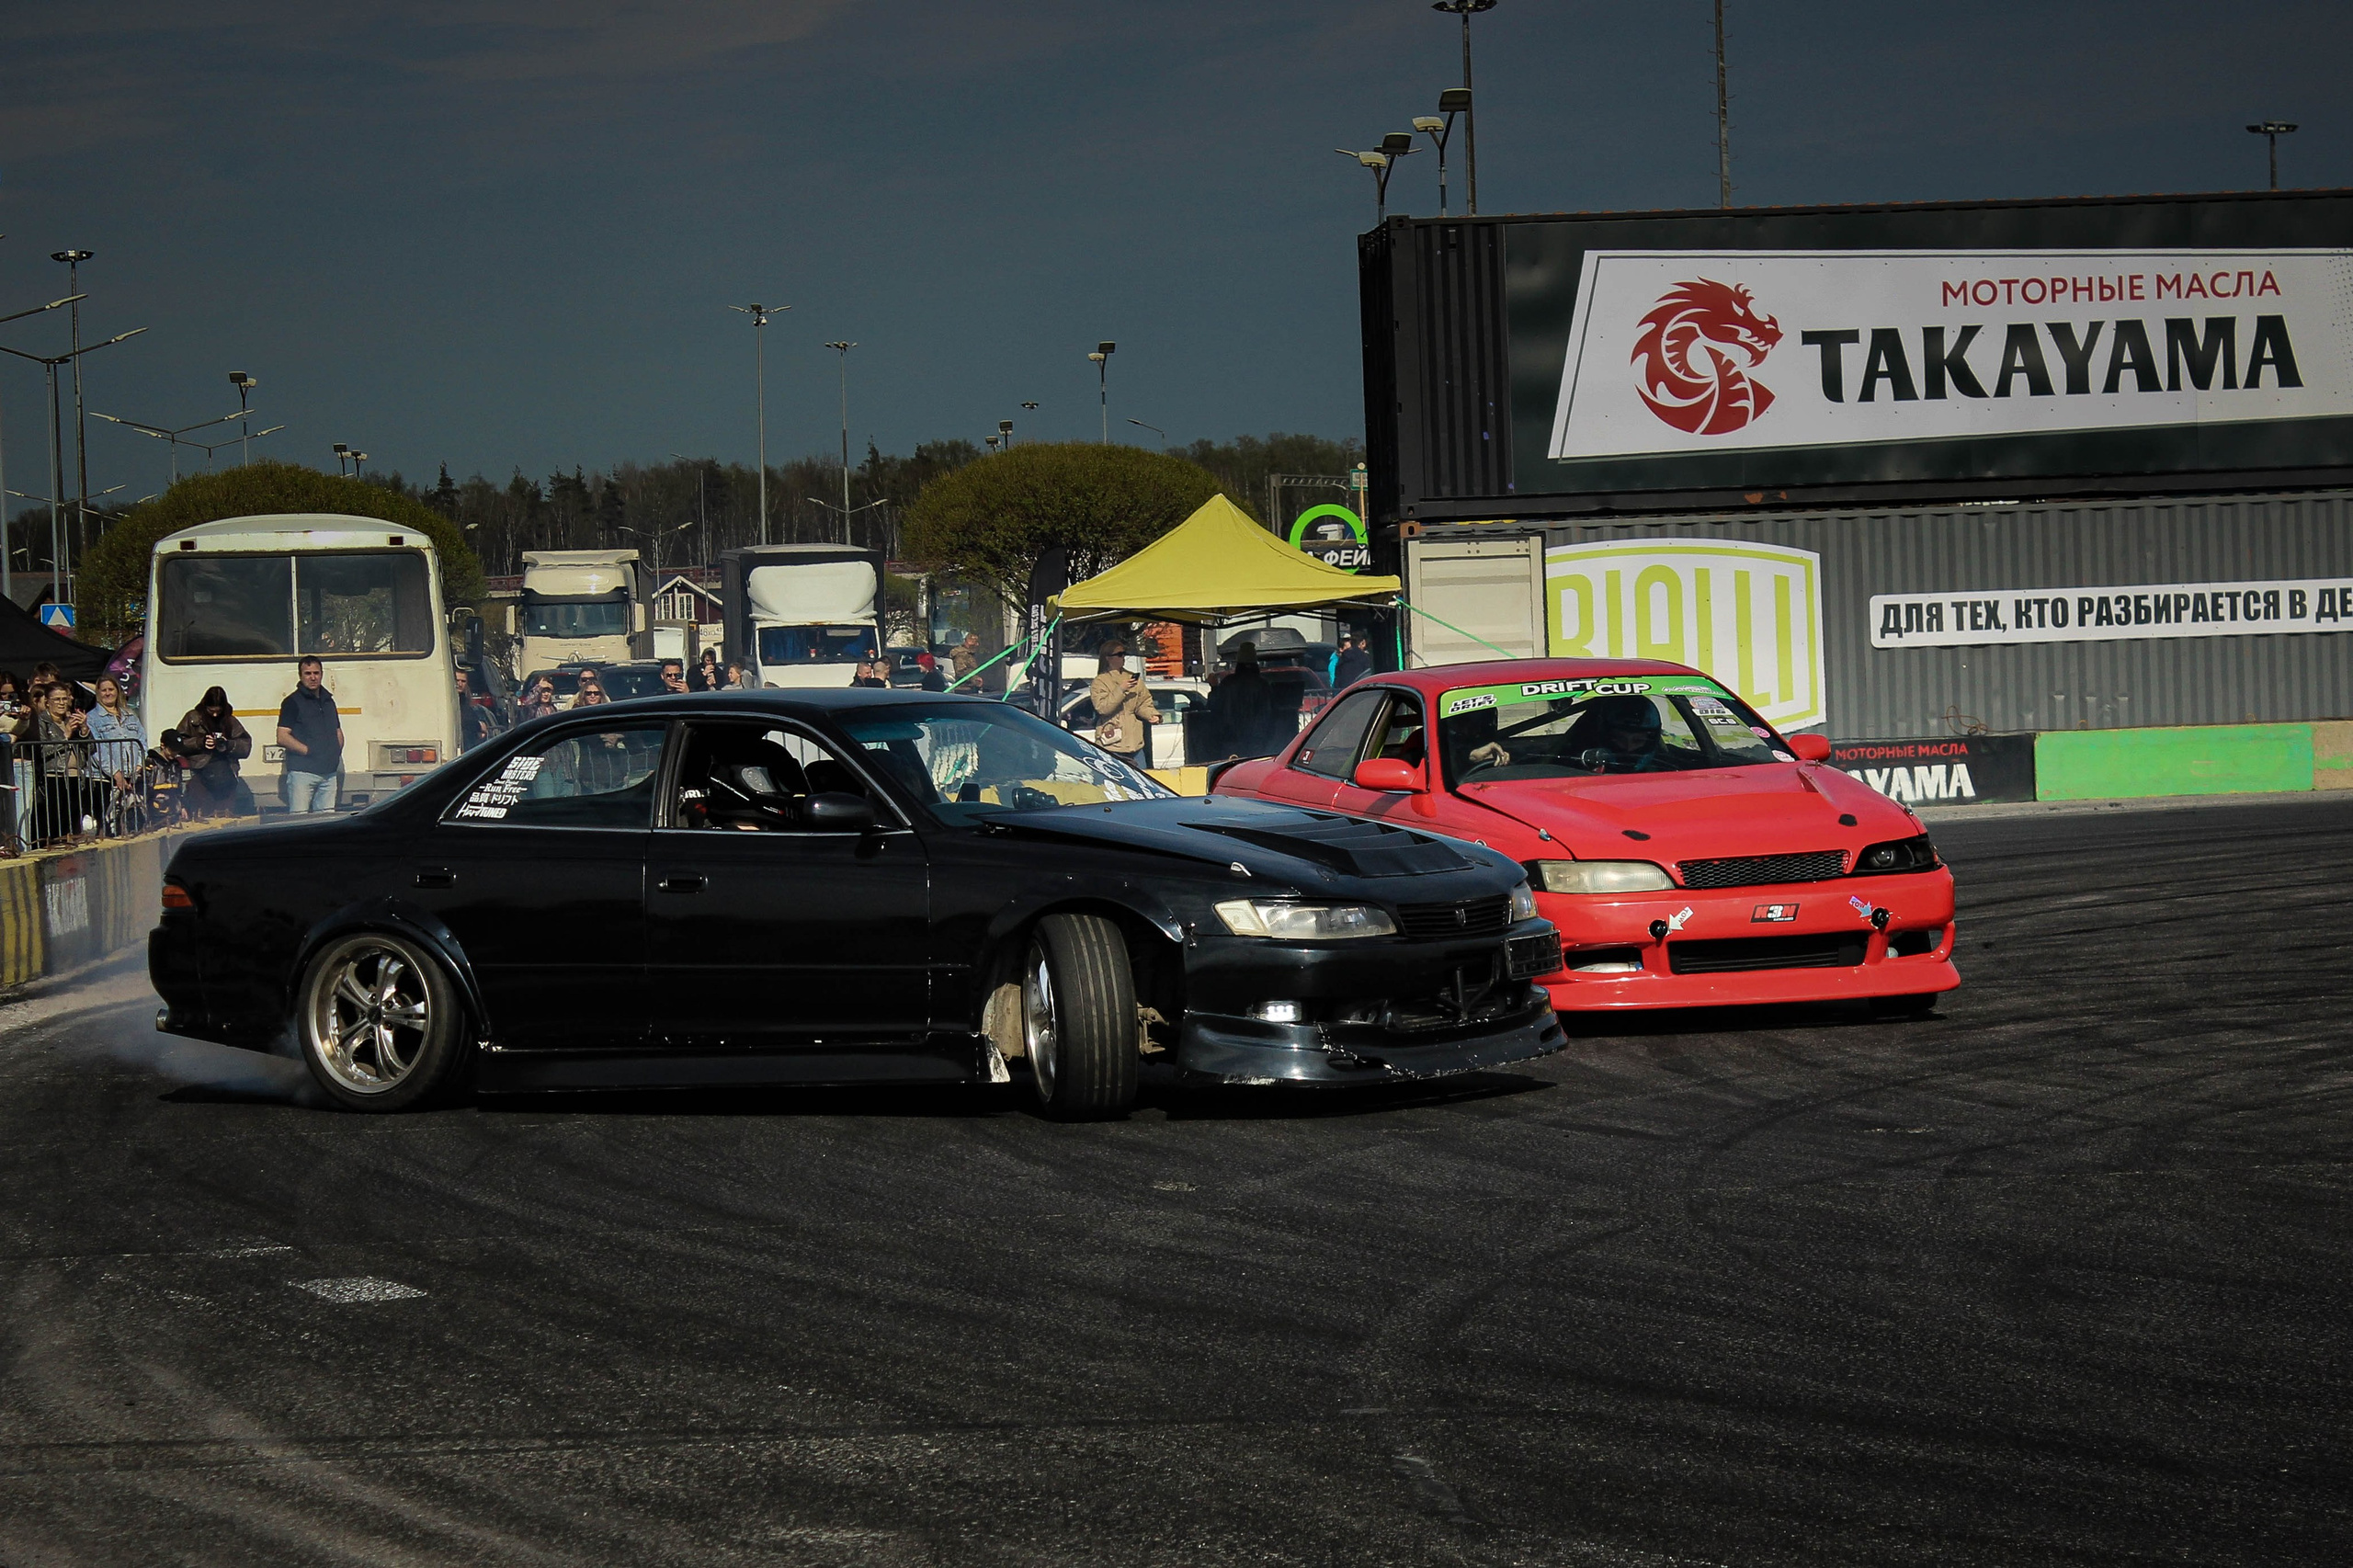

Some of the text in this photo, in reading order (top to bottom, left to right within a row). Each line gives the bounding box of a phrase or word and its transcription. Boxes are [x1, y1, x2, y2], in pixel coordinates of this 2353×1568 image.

[1941, 269, 2281, 307] МОТОРНЫЕ МАСЛА
[1801, 314, 2305, 403] TAKAYAMA
[1324, 544, 1370, 566] ФЕЙ
[1880, 602, 1943, 639] ДЛЯ
[1950, 599, 2008, 634] ТЕХ,
[2015, 597, 2070, 630] КТО
[2077, 589, 2281, 627] РАЗБИРАЕТСЯ
[2289, 589, 2307, 619] В
[1522, 679, 1597, 696] DRIFT
[1595, 683, 1651, 695] CUP
[1836, 743, 1969, 761] МОТОРНЫЕ МАСЛА
[1847, 764, 1975, 801] YAMA
